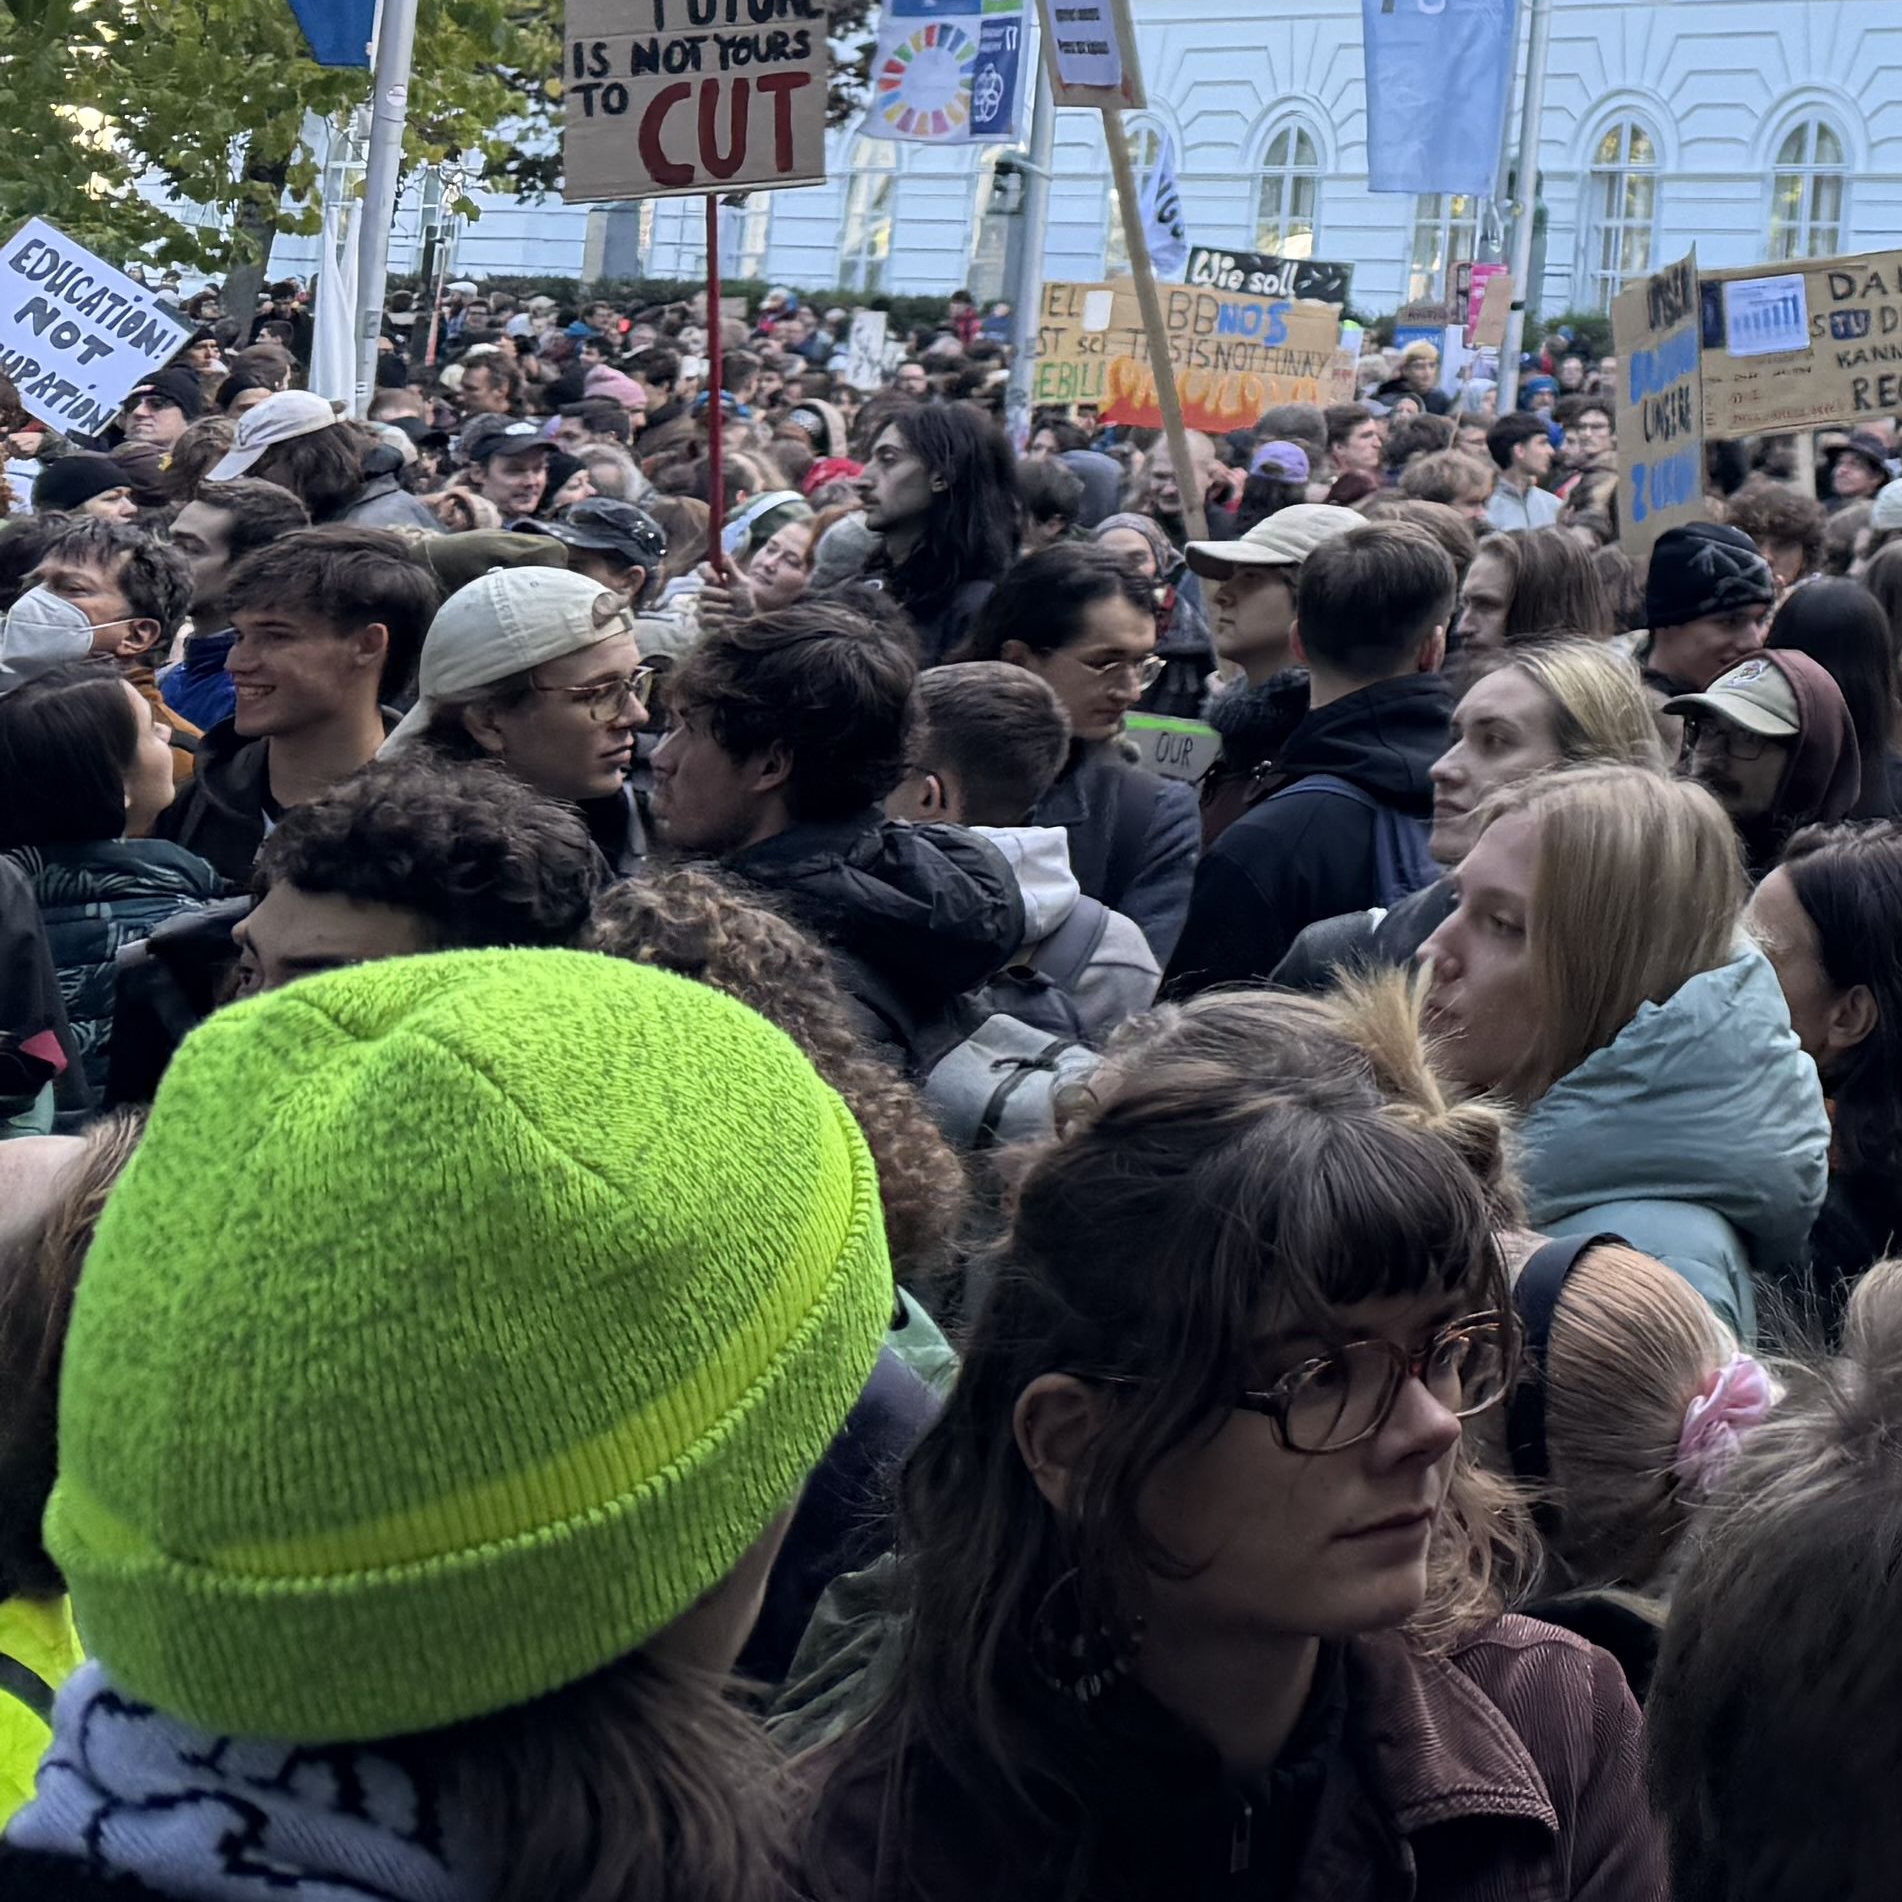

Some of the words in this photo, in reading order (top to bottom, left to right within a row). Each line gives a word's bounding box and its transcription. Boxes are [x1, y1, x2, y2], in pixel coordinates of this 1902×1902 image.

[573, 41, 611, 79] IS
[631, 35, 708, 76] NOT
[713, 30, 811, 71] YOURS
[570, 81, 629, 117] TO
[638, 71, 811, 186] CUT
[8, 238, 178, 360] EDUCATION!
[1190, 250, 1244, 291] Wie
[1249, 262, 1298, 297] soll
[13, 297, 115, 366] NOT
[0, 343, 118, 434] UPATION
[1156, 731, 1194, 769] OUR
